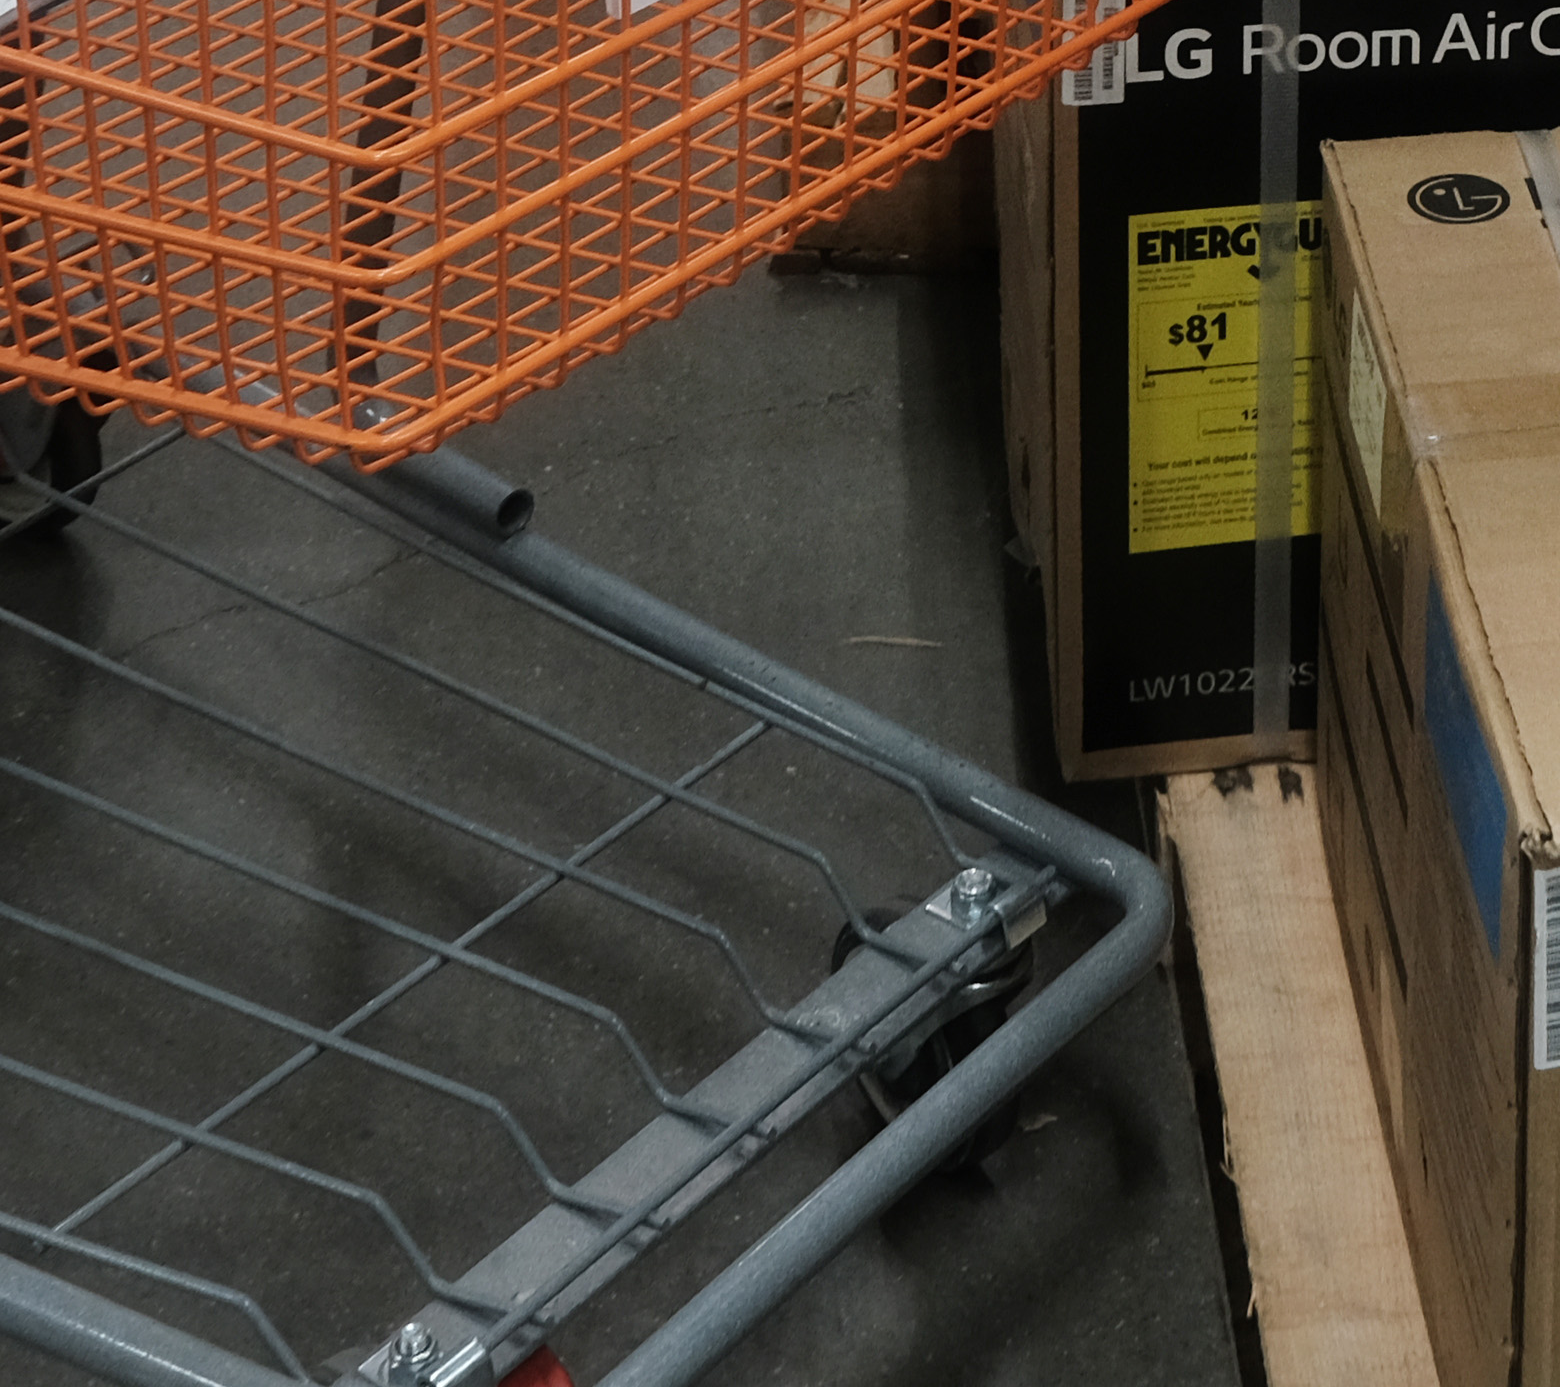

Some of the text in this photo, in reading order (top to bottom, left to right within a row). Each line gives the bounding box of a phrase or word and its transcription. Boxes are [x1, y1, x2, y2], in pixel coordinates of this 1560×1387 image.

[1127, 27, 1214, 83] LG
[1241, 22, 1421, 76] Room
[1167, 312, 1230, 348] $81
